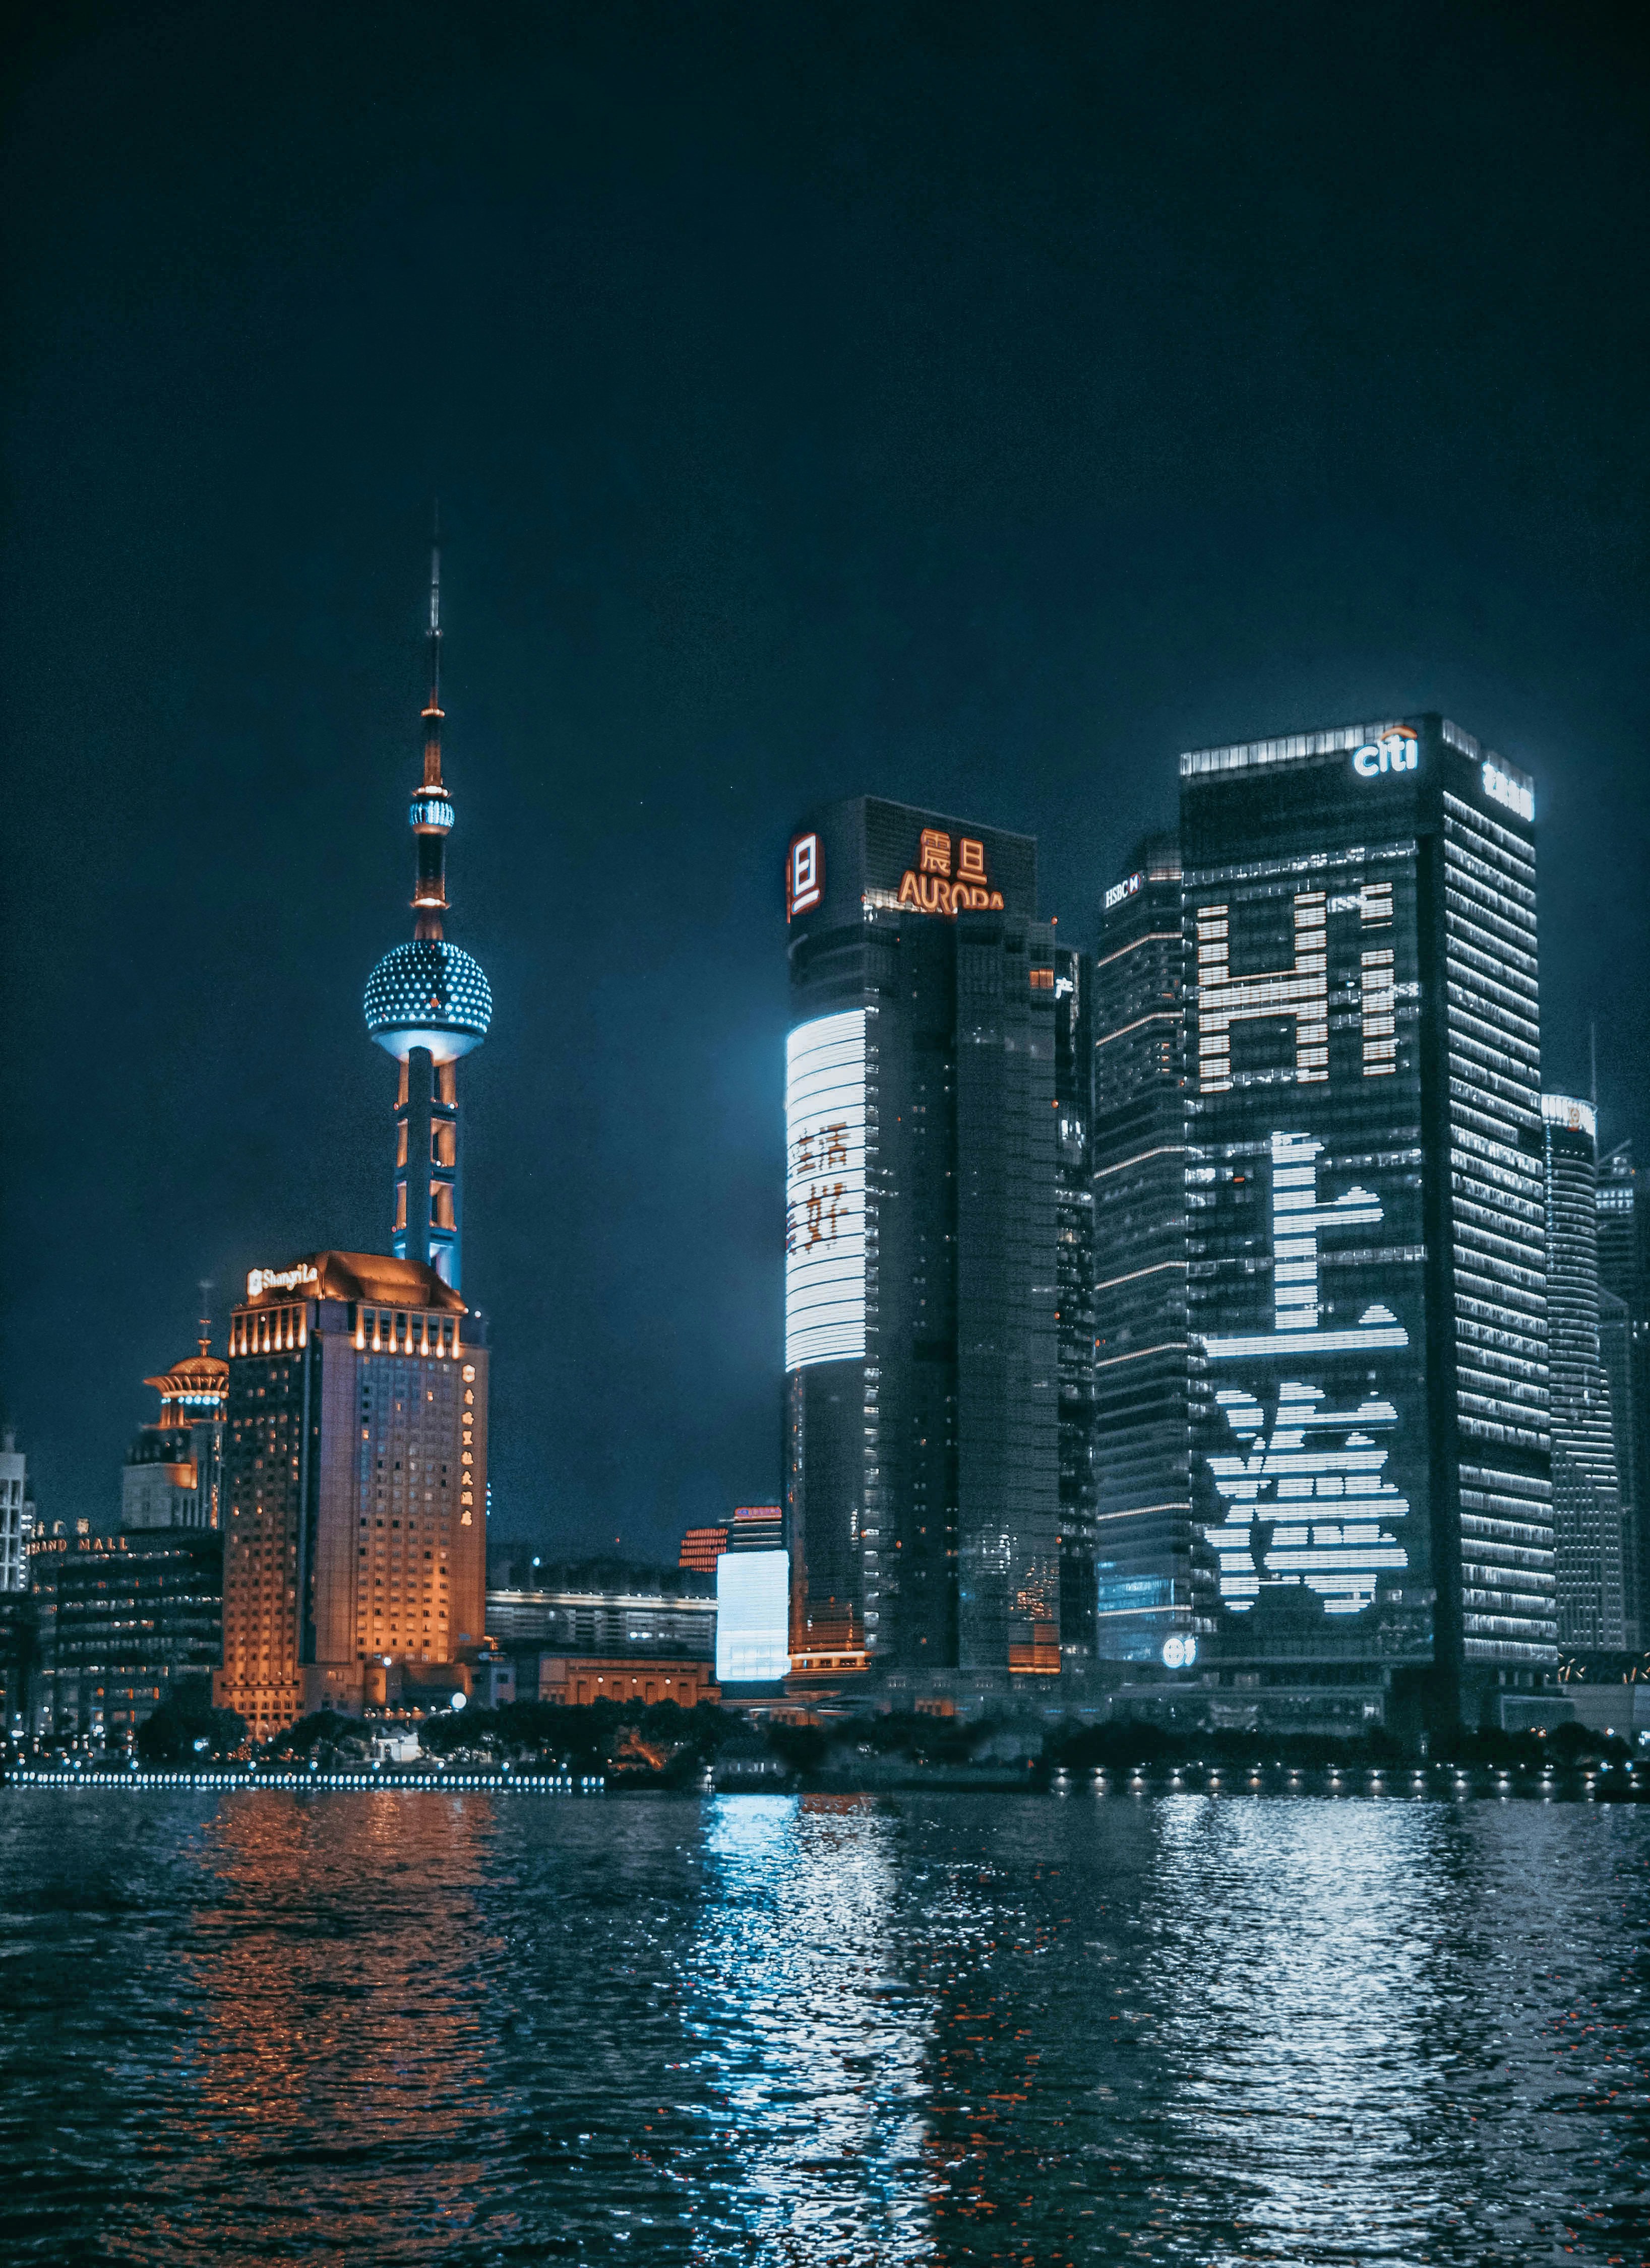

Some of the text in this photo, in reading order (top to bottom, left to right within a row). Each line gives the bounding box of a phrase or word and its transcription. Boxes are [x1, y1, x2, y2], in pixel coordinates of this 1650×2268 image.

[1353, 734, 1418, 777] citi
[920, 828, 988, 885] 震旦
[1105, 880, 1129, 908] HSBC
[79, 1537, 128, 1551] MALL
